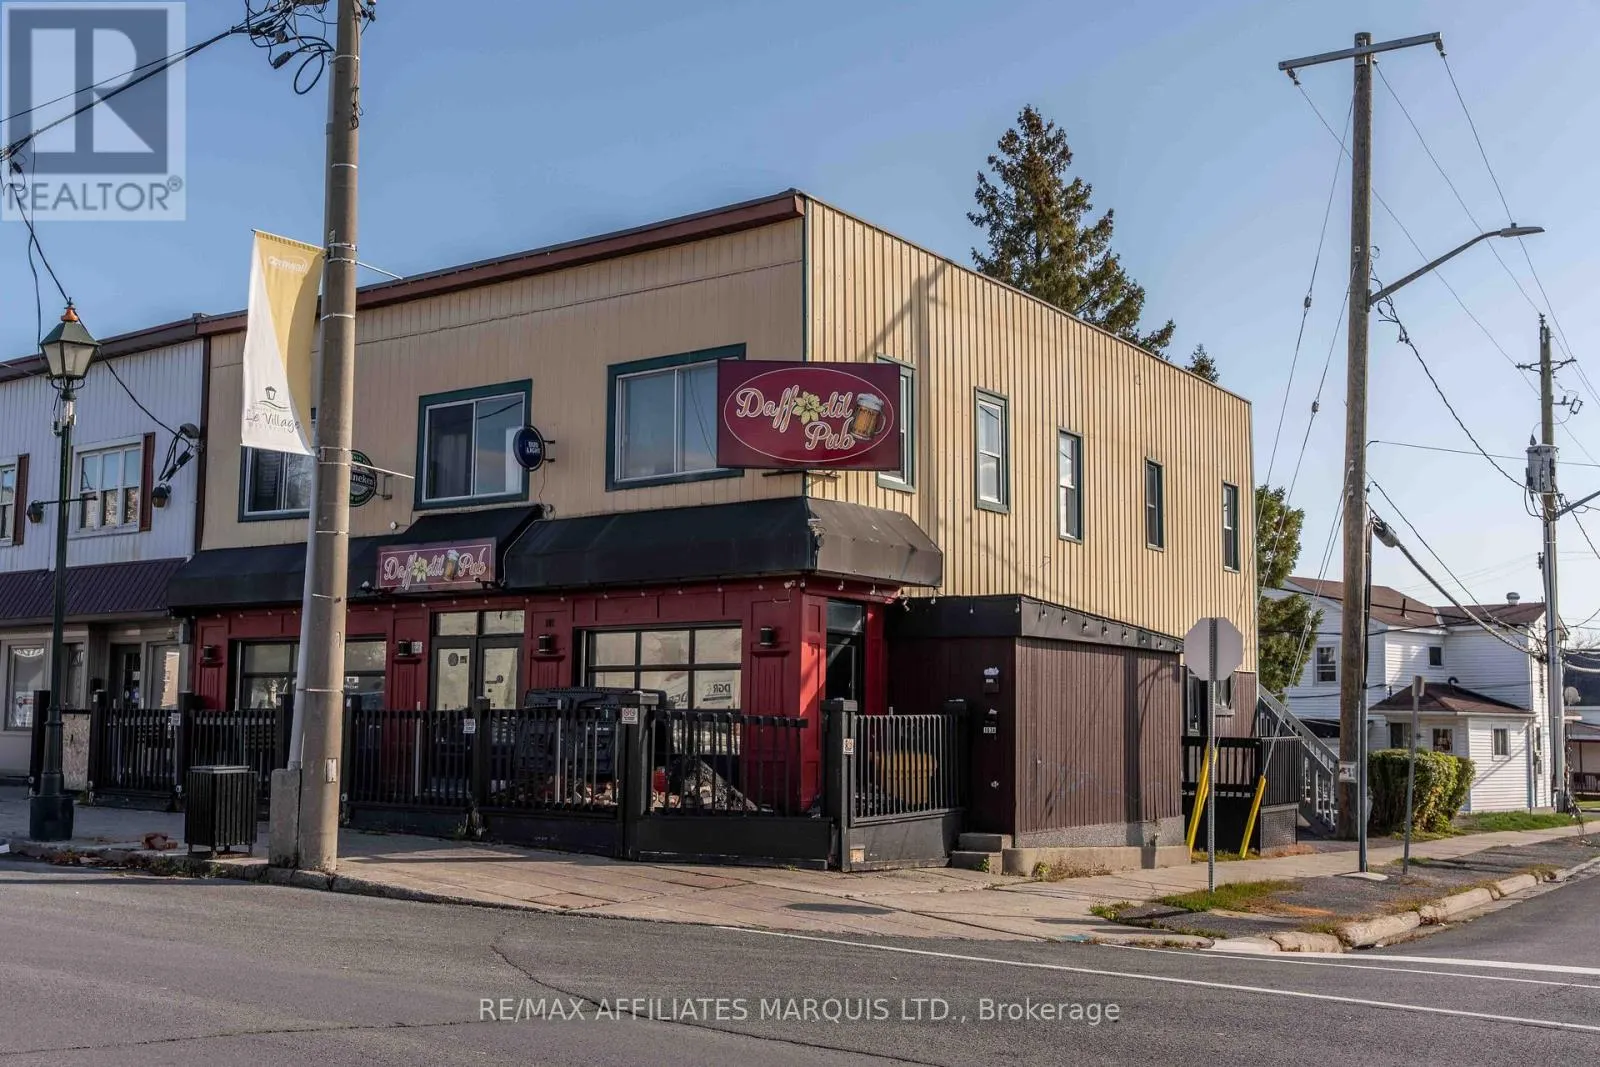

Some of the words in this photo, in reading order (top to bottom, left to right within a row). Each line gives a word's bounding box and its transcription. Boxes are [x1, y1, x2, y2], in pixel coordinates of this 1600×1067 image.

[245, 408, 259, 422] Le
[805, 416, 856, 450] Pub
[458, 547, 486, 577] Pub
